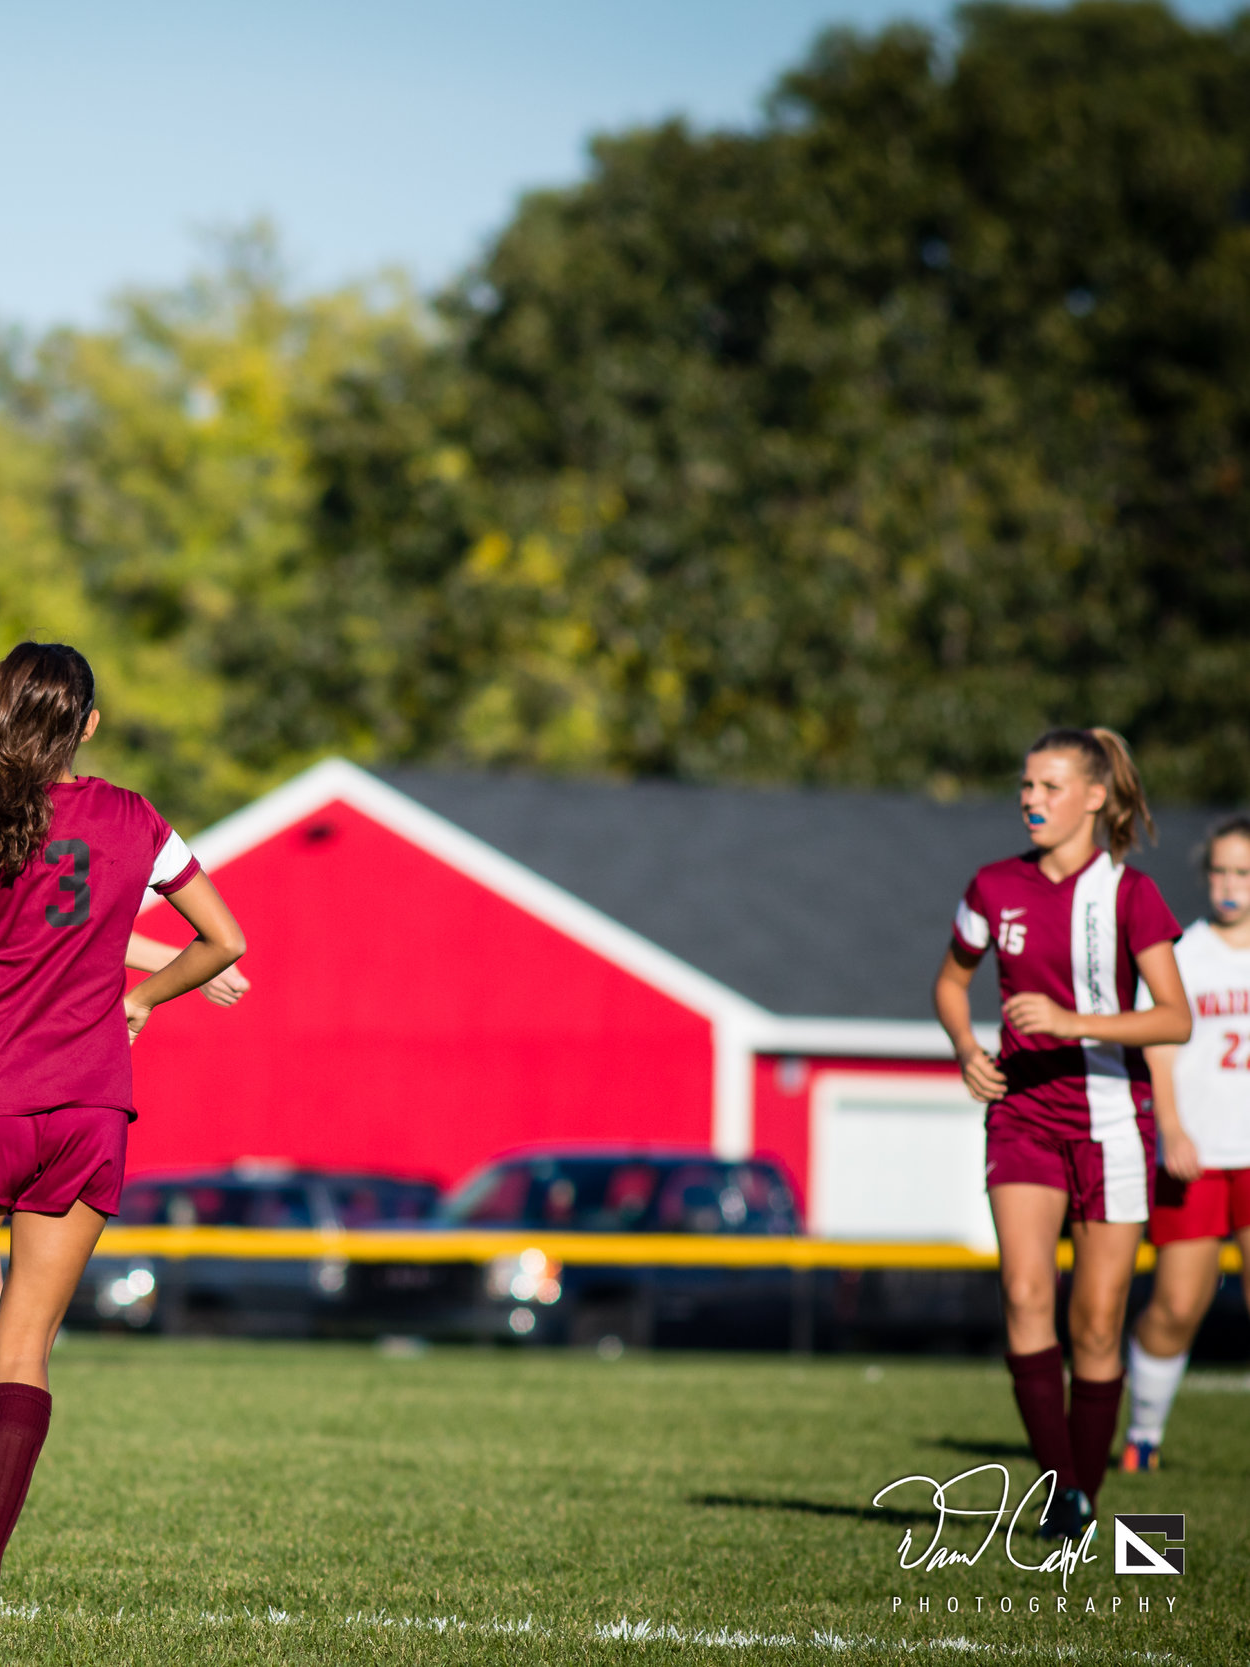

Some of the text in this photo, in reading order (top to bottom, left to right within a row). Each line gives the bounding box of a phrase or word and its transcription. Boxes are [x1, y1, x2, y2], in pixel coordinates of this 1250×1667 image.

[45, 838, 91, 928] 3
[998, 922, 1027, 955] 15
[1220, 1031, 1250, 1070] 2
